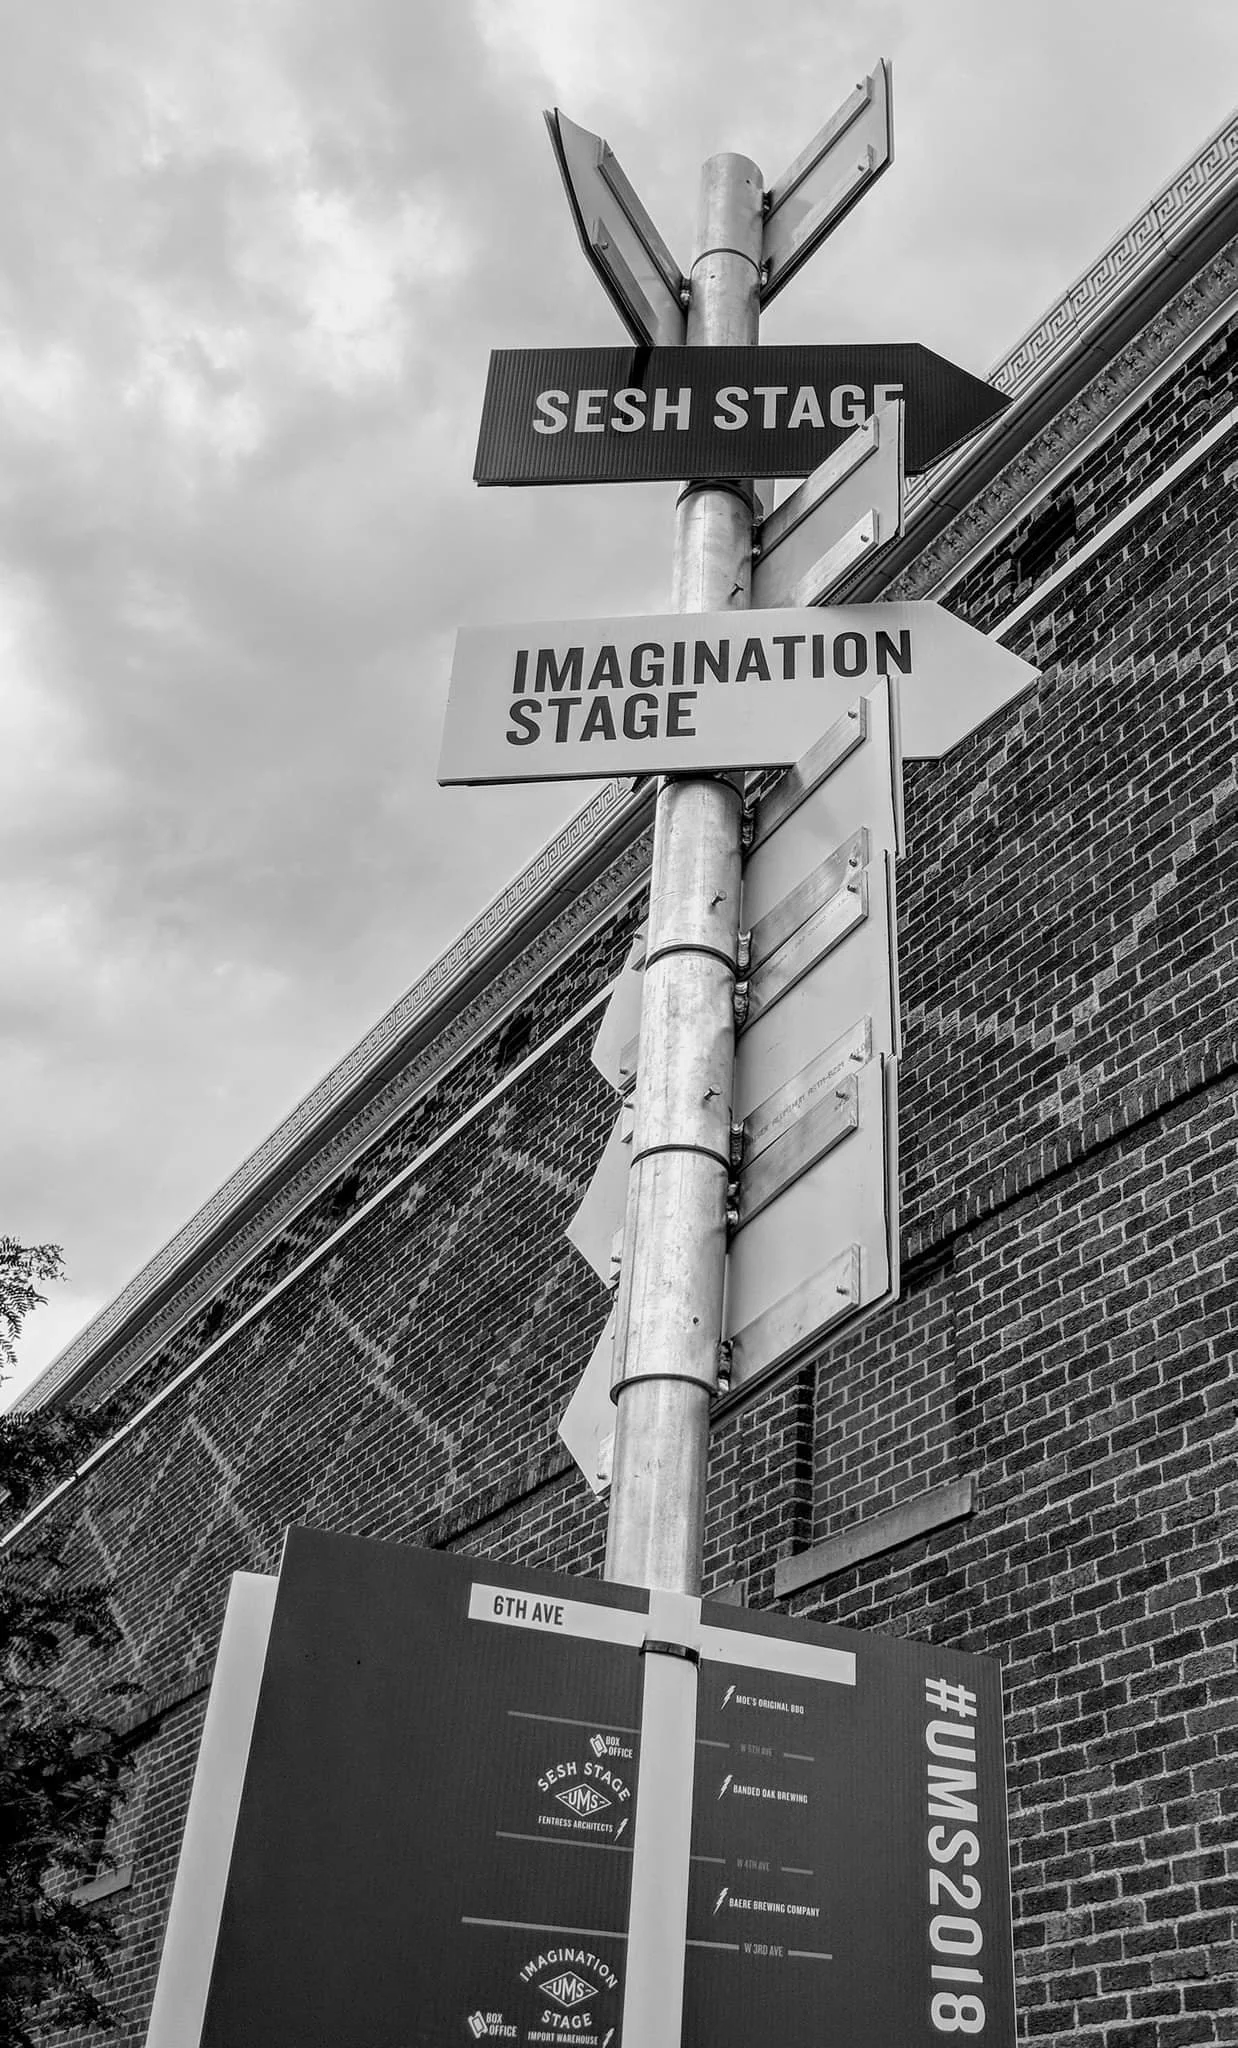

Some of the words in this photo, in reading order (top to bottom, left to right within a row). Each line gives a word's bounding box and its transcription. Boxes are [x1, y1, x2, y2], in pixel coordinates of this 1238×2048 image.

[532, 386, 692, 435] SESH
[512, 630, 913, 694] IMAGINATION
[506, 691, 698, 746] STAGE
[494, 1596, 527, 1619] 6TH
[532, 1602, 564, 1626] AVE
[758, 1698, 789, 1712] ORIGINAL
[605, 1736, 620, 1747] BOX
[608, 1746, 633, 1759] OFFICE
[537, 1761, 577, 1792] SESH
[583, 1761, 632, 1802] STAGE
[568, 1788, 599, 1812] UMS
[733, 1784, 760, 1797] BANDED
[762, 1788, 776, 1799] OAK
[777, 1790, 808, 1804] BREWING
[538, 1815, 572, 1828] FENTRESS
[573, 1820, 614, 1833] ARCHITECTS
[924, 1677, 986, 2034] #UMS2018
[729, 1897, 752, 1909] BAERE
[753, 1900, 786, 1913] BREWING
[786, 1904, 820, 1917] COMPANY
[753, 1944, 768, 1955] 3RD
[769, 1945, 784, 1957] AVE
[519, 1948, 619, 1989] IMAGINATION
[552, 1977, 585, 2001] UMS
[486, 2012, 503, 2024] BOX
[541, 2009, 593, 2030] STAGE
[488, 2024, 518, 2037] OFFICE
[527, 2031, 555, 2042] IMPORT
[556, 2033, 599, 2046] WAREHOUSE
